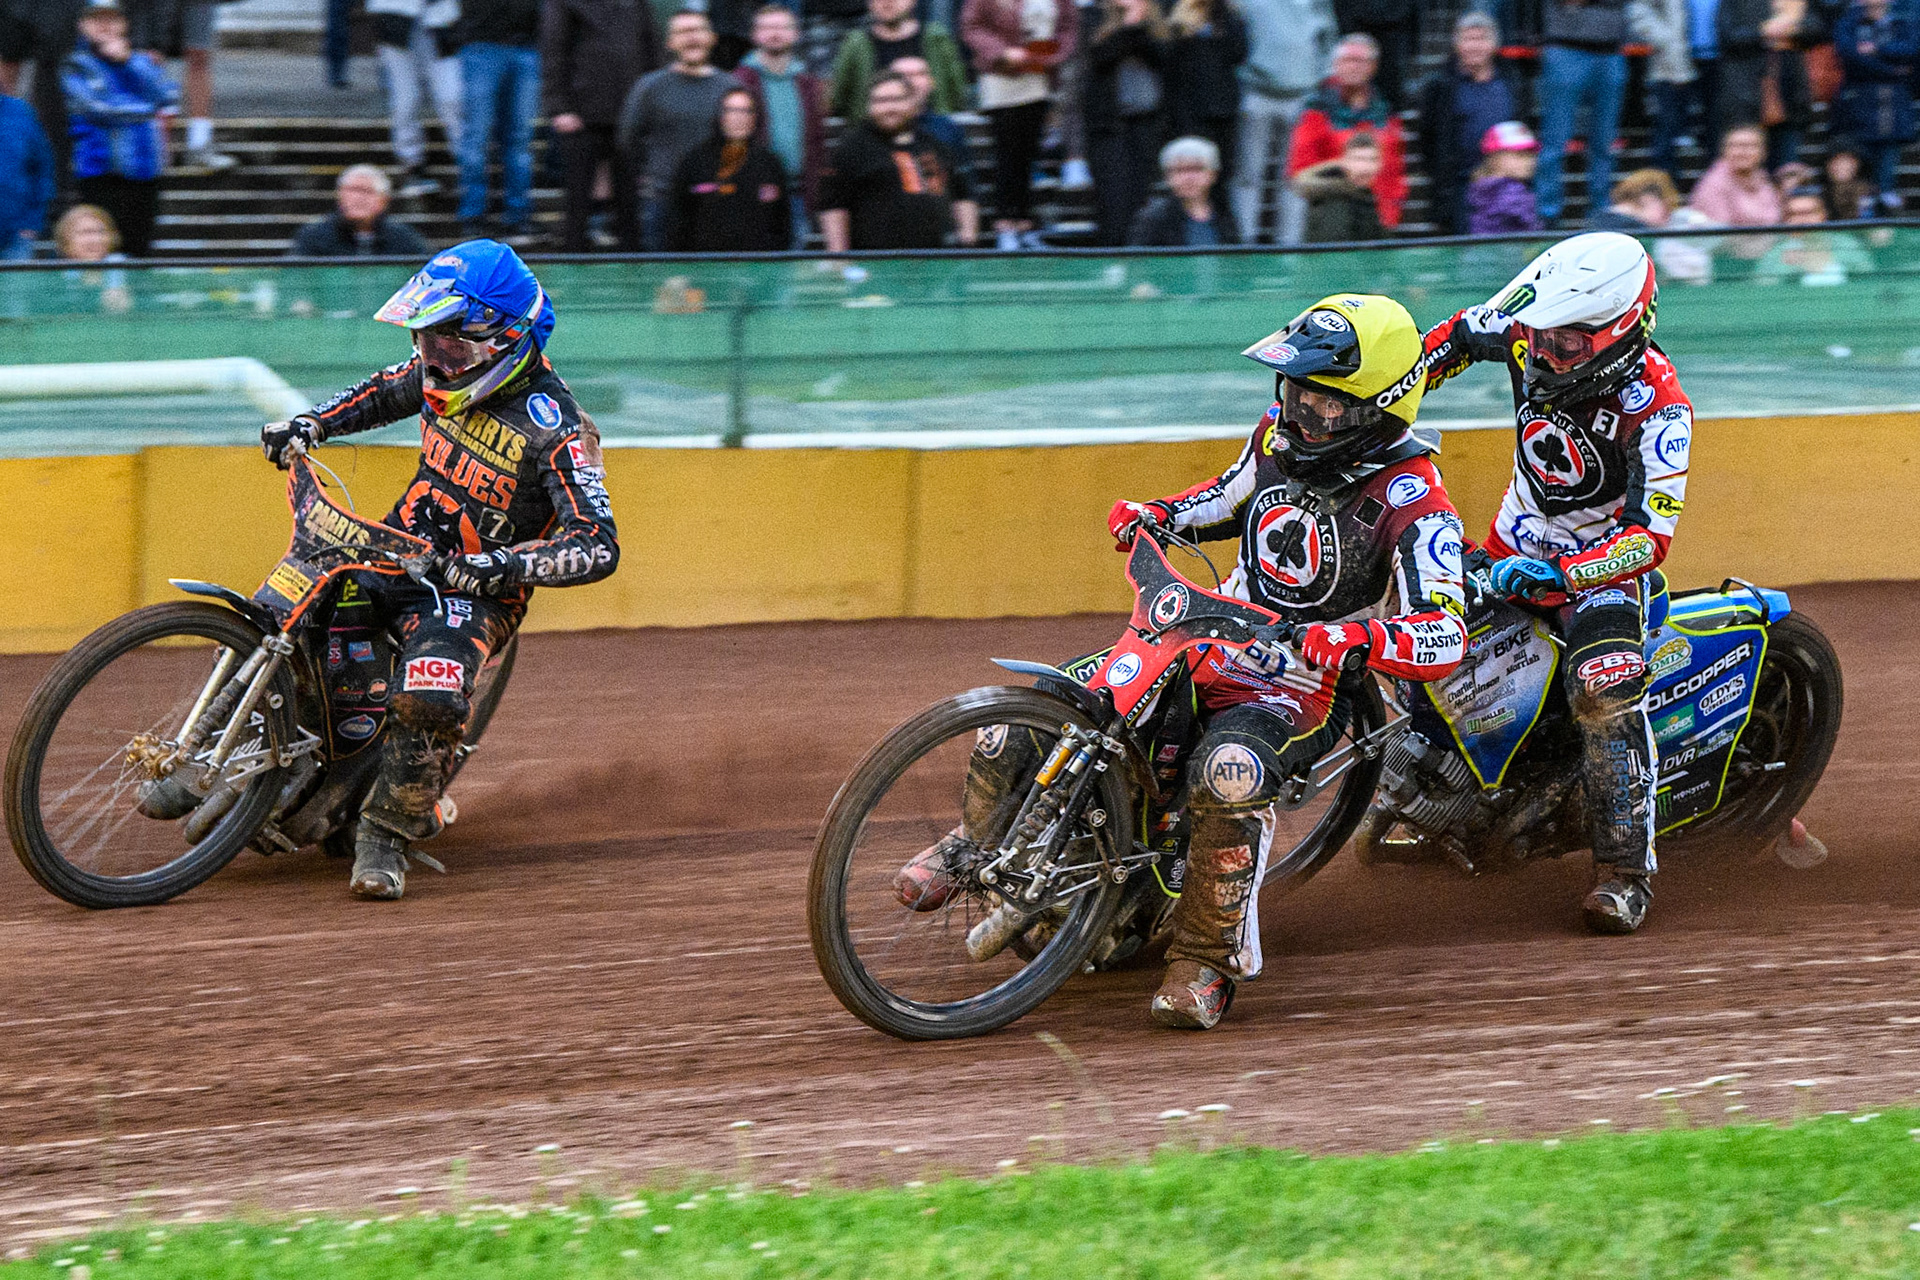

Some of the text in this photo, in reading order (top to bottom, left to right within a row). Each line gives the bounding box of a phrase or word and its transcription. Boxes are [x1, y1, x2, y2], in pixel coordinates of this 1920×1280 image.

[1597, 411, 1615, 437] 3
[1552, 412, 1575, 434] VUE
[1575, 438, 1597, 468] ACES
[488, 512, 507, 539] 7
[1319, 523, 1335, 564] ACES
[519, 543, 612, 578] Taffys
[1573, 547, 1649, 579] AGROMIX
[1416, 632, 1462, 649] PLASTICS
[1415, 651, 1437, 664] LTD
[1581, 655, 1643, 676] CBS
[408, 660, 461, 682] NGK
[408, 680, 434, 688] SPARK
[1700, 674, 1744, 709] OLDY'S
[1654, 715, 1692, 738] MOTOREX
[1662, 746, 1696, 772] DVR
[1672, 780, 1711, 801] MONSTER
